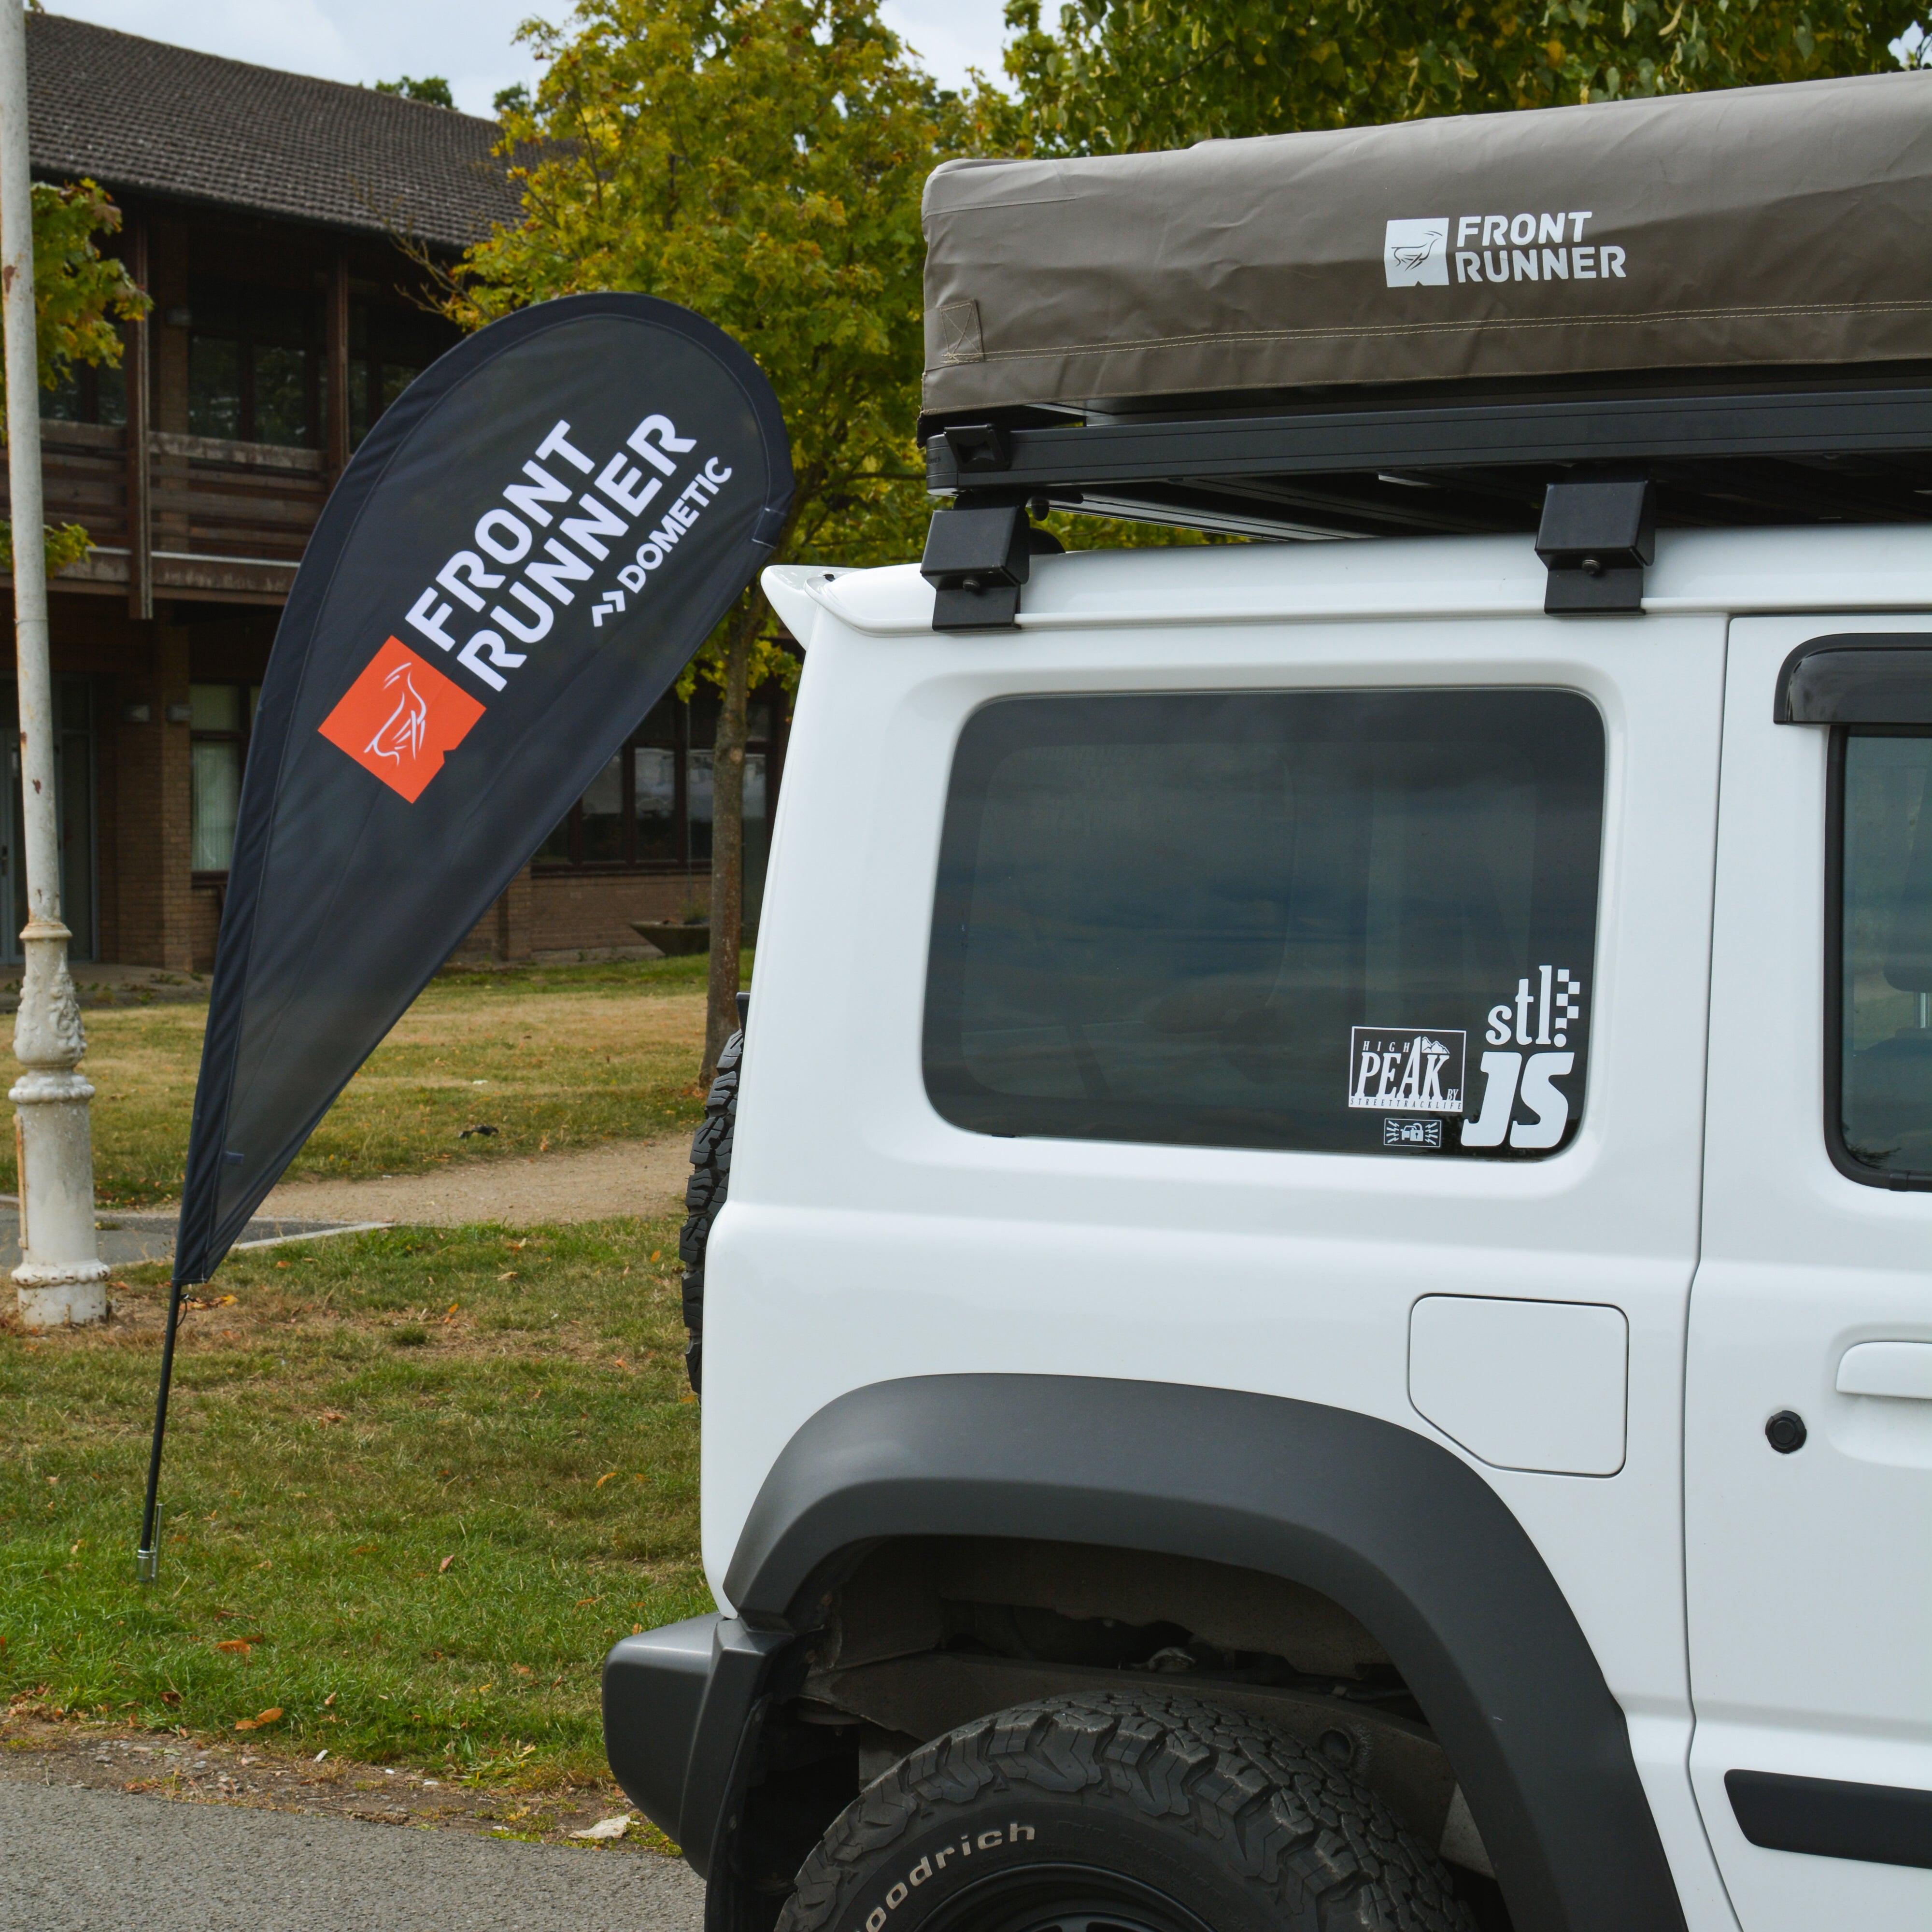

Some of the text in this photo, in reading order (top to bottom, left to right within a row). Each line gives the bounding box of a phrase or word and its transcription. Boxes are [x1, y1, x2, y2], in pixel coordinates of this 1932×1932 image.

[1455, 246, 1626, 283] RUNNER
[1457, 211, 1592, 247] FRONT
[405, 420, 595, 652] FRONT
[457, 414, 696, 692] RUNNER
[617, 456, 732, 594] DOMETIC
[1354, 1036, 1449, 1101] PEAK
[1363, 1040, 1410, 1052] HIGH
[1446, 1088, 1459, 1101] BY
[1461, 1051, 1575, 1148] JS
[856, 1823, 1035, 1932] oodrich
